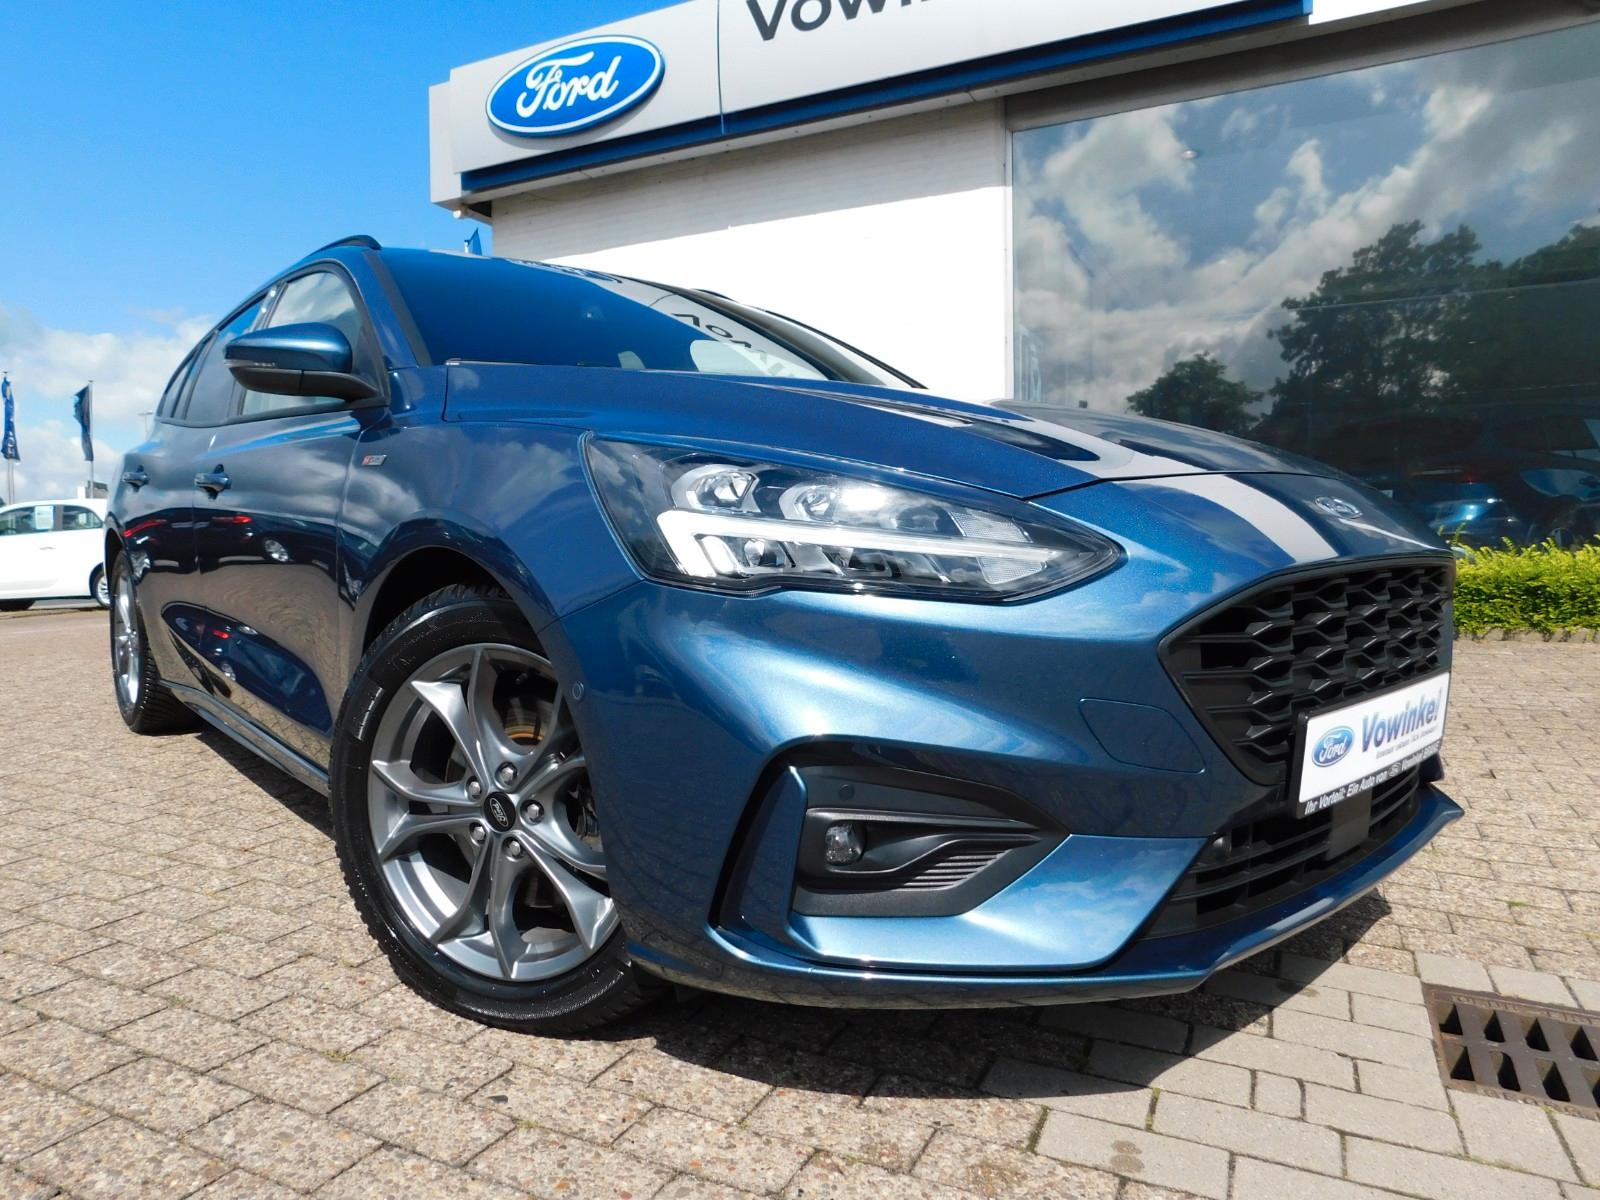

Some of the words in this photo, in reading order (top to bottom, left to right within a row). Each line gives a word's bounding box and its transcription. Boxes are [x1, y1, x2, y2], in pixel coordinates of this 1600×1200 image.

[516, 54, 622, 119] Ford
[1362, 688, 1443, 753] Vowinkel
[1319, 733, 1347, 763] Ford
[1346, 783, 1359, 797] Ein
